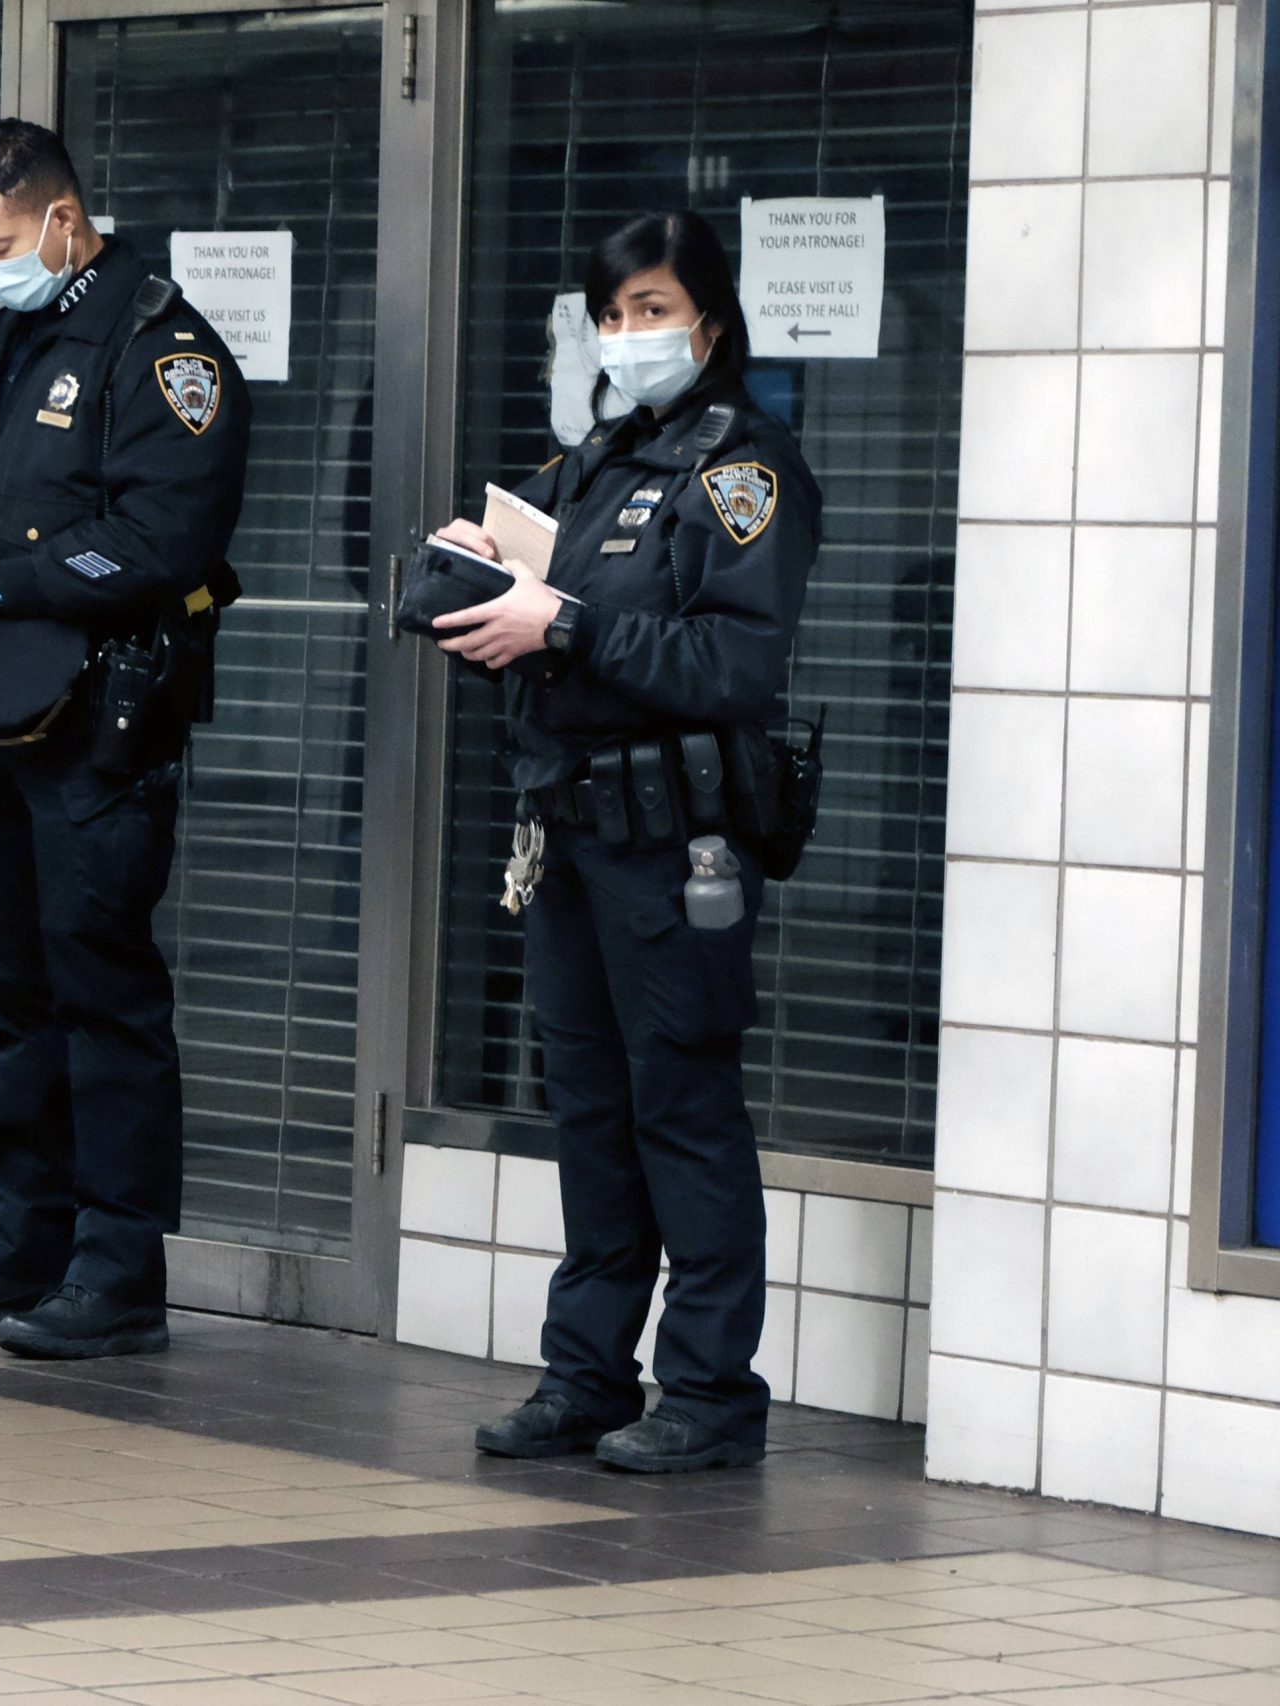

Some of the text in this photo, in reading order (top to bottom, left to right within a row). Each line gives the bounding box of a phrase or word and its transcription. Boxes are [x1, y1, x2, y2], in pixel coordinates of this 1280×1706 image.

[769, 212, 857, 226] THANK YOU FOR
[759, 234, 865, 249] YOUR PATRONAGE!
[193, 246, 269, 259] THANK YOU FOR
[186, 267, 276, 280] YOUR PATRONAGE!
[767, 281, 853, 294] PLEASE VISIT US
[228, 310, 251, 322] VISIT
[253, 309, 266, 322] US
[759, 303, 859, 317] ACROSS THE HALL!
[225, 331, 242, 343] THE
[244, 331, 271, 343] HALL!
